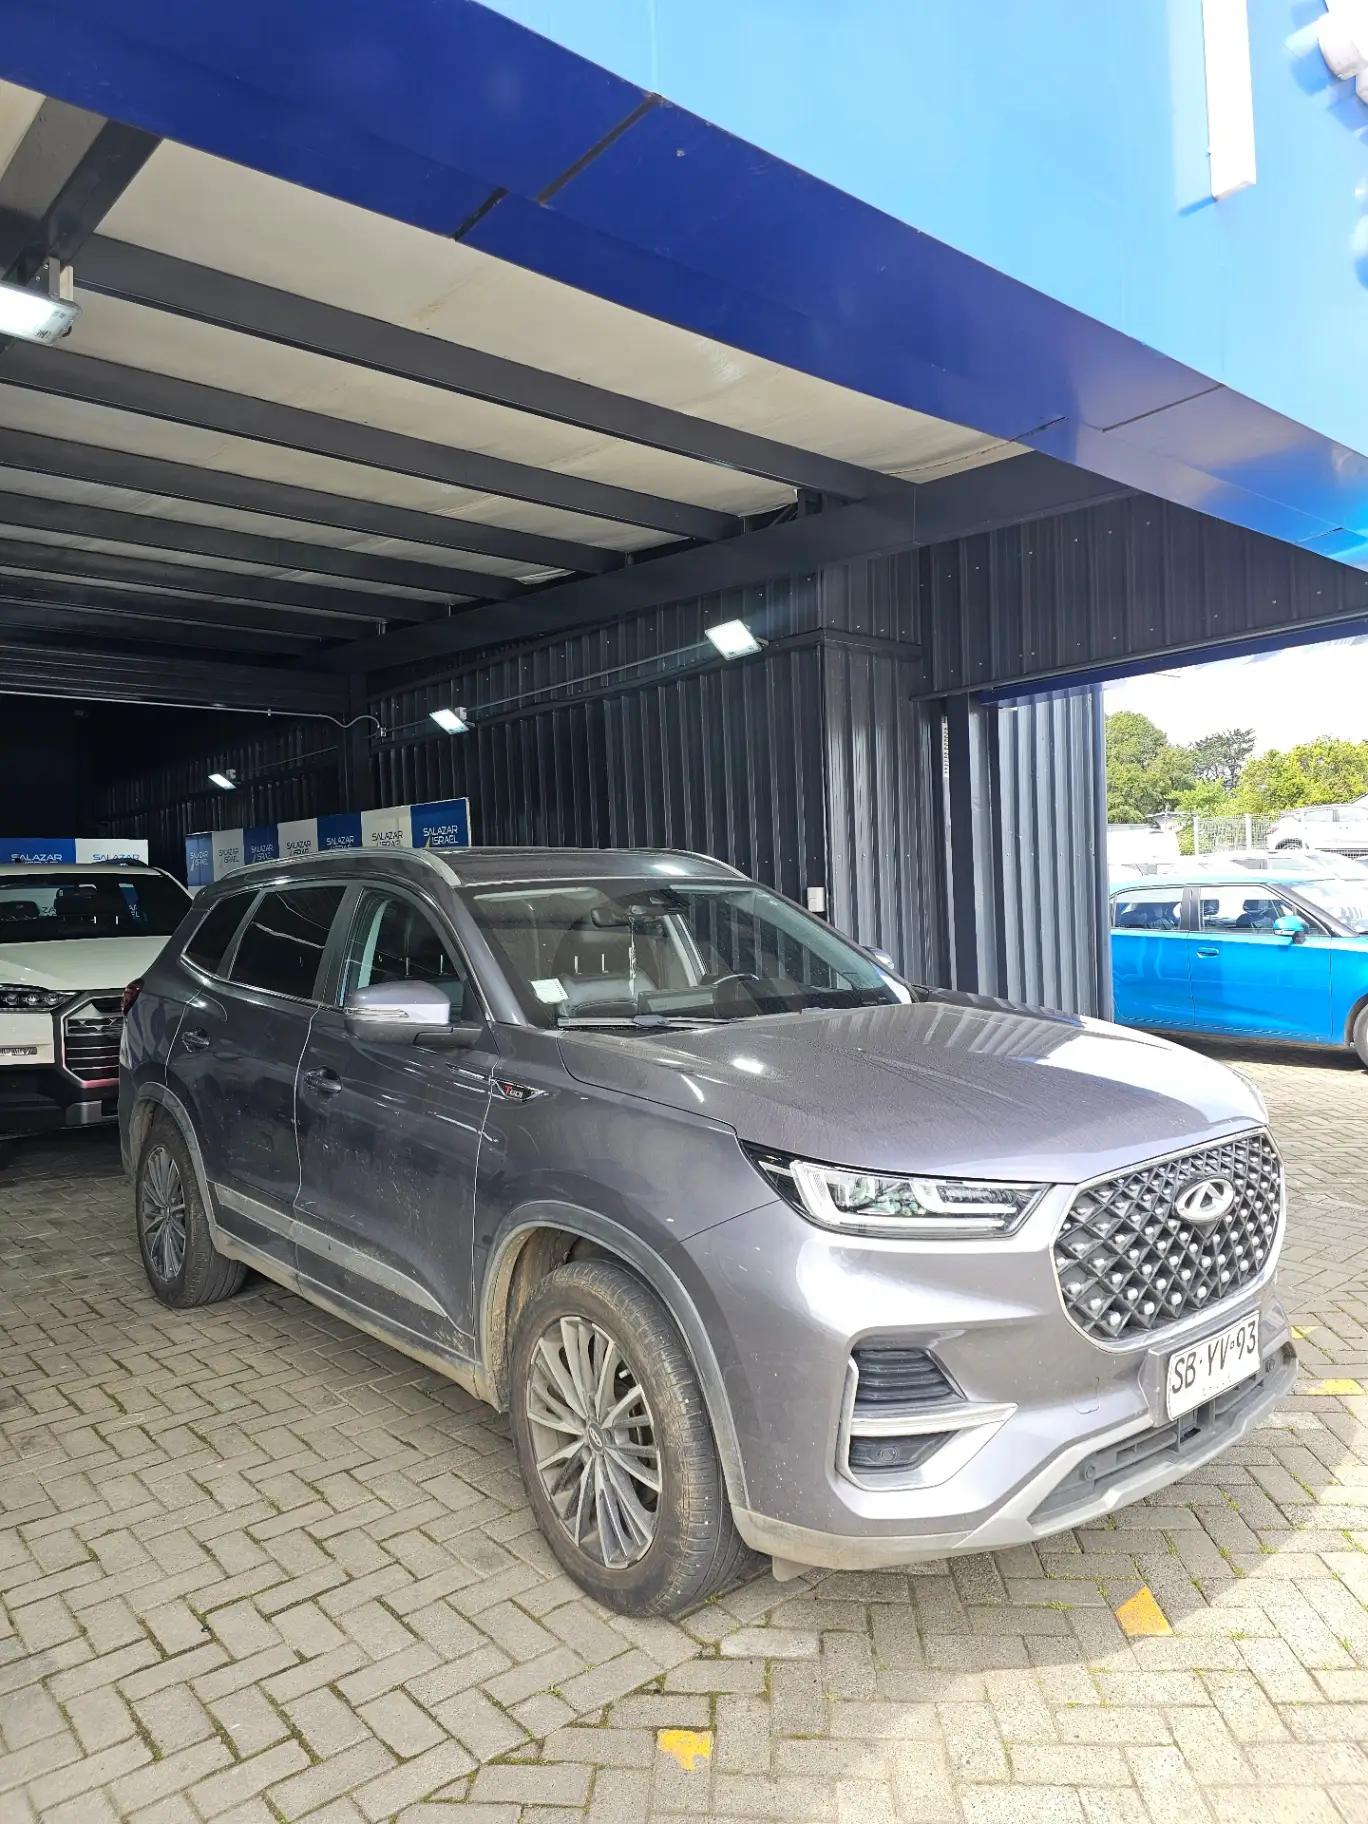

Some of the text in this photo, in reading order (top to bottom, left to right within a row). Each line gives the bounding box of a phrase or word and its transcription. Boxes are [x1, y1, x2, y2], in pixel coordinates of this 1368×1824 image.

[371, 830, 404, 842] SALAZAR
[422, 825, 458, 837] SALAZAR
[326, 835, 355, 846] SALAZAR
[431, 835, 460, 845] ISRAEL
[10, 853, 63, 863] SALAZAR
